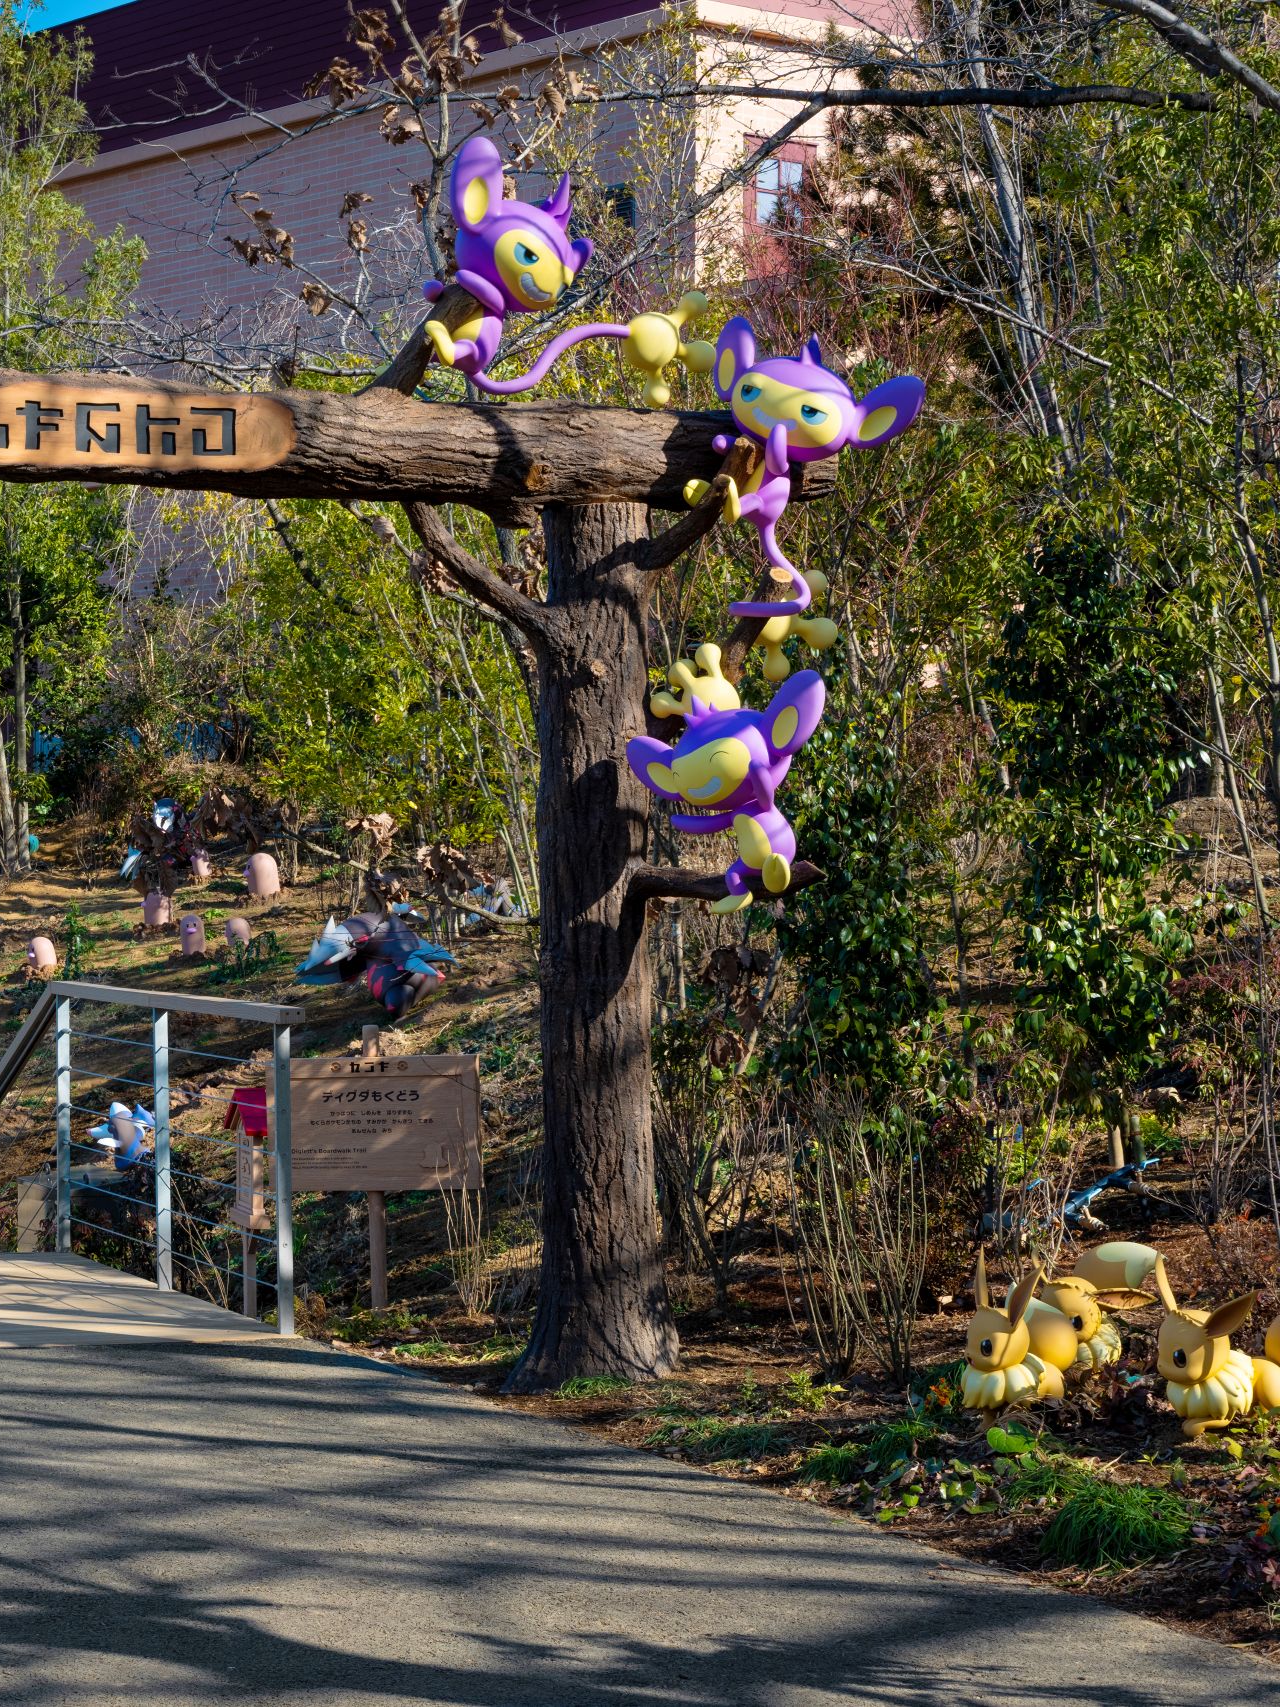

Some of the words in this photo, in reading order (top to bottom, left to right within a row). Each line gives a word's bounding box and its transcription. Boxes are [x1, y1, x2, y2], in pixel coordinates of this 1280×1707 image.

[322, 1090, 420, 1103] ディグダもくどう
